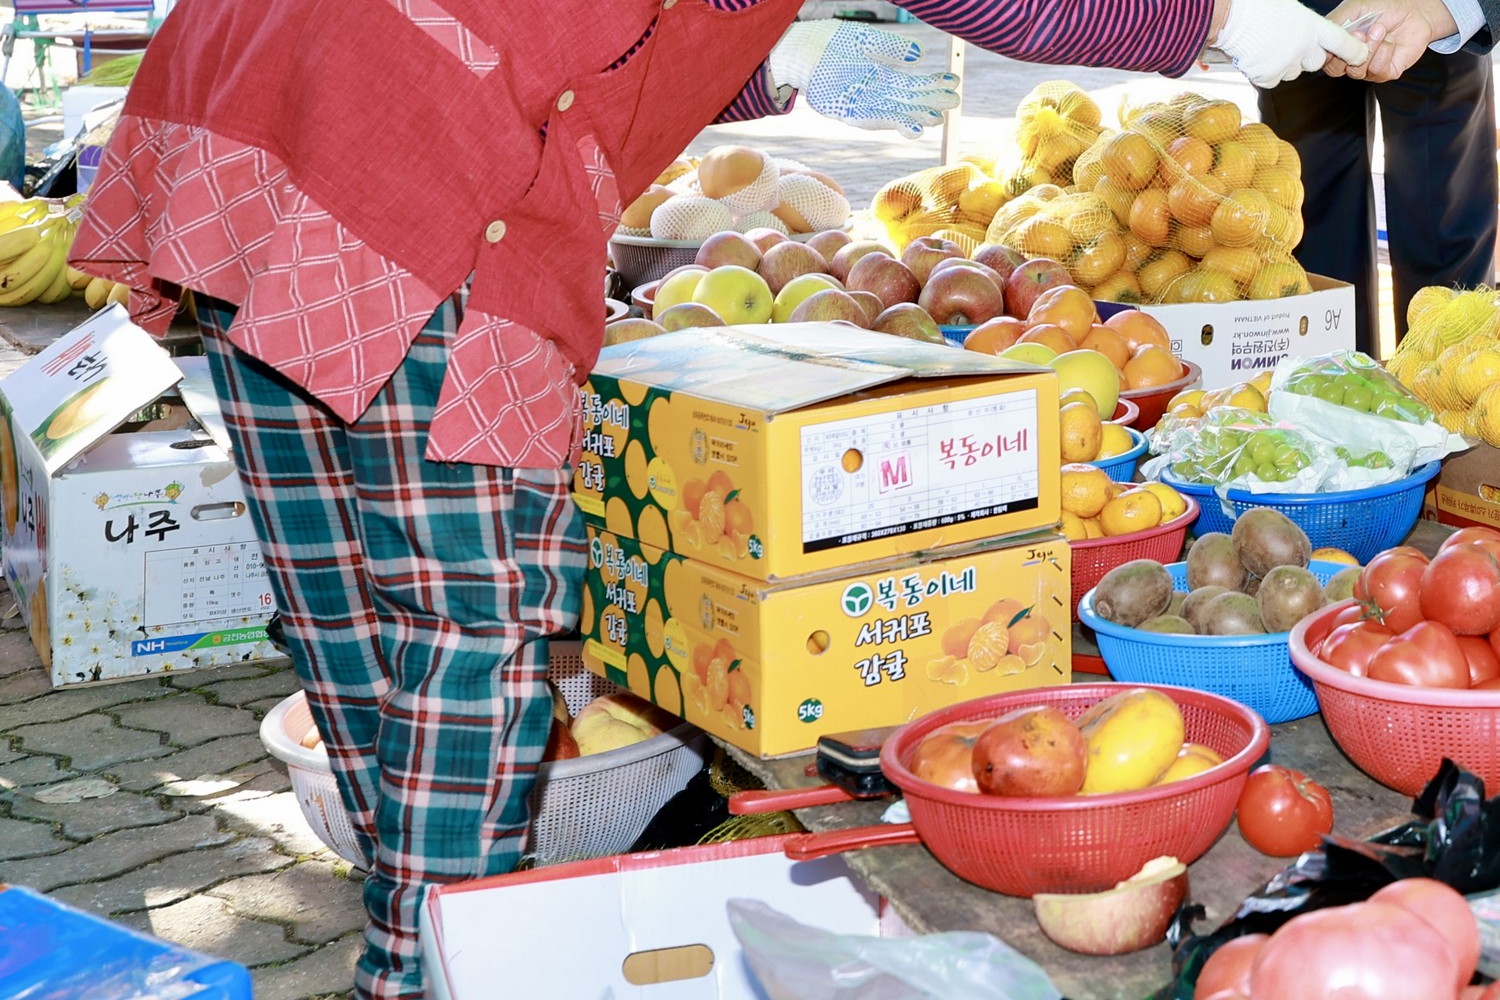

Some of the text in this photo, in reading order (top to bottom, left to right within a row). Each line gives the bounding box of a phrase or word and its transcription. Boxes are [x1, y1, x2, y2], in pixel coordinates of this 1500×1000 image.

[1232, 327, 1290, 340] www.jinwon.kr
[1234, 315, 1263, 323] VIETNAM
[1325, 309, 1341, 331] A6
[1231, 338, 1290, 356] (주)진원무역
[939, 428, 1028, 470] 복동이네
[579, 461, 604, 491] 감귤
[880, 455, 908, 487] M
[104, 510, 180, 545] 나주
[604, 543, 649, 588] 복동이네
[258, 593, 272, 606] 16
[605, 582, 637, 614] 서귀포
[875, 566, 976, 611] 복동이네
[605, 614, 627, 646] 감귤
[854, 610, 933, 647] 서귀포
[137, 640, 165, 653] NH
[854, 650, 907, 687] 감귤
[798, 701, 824, 721] 5kg
